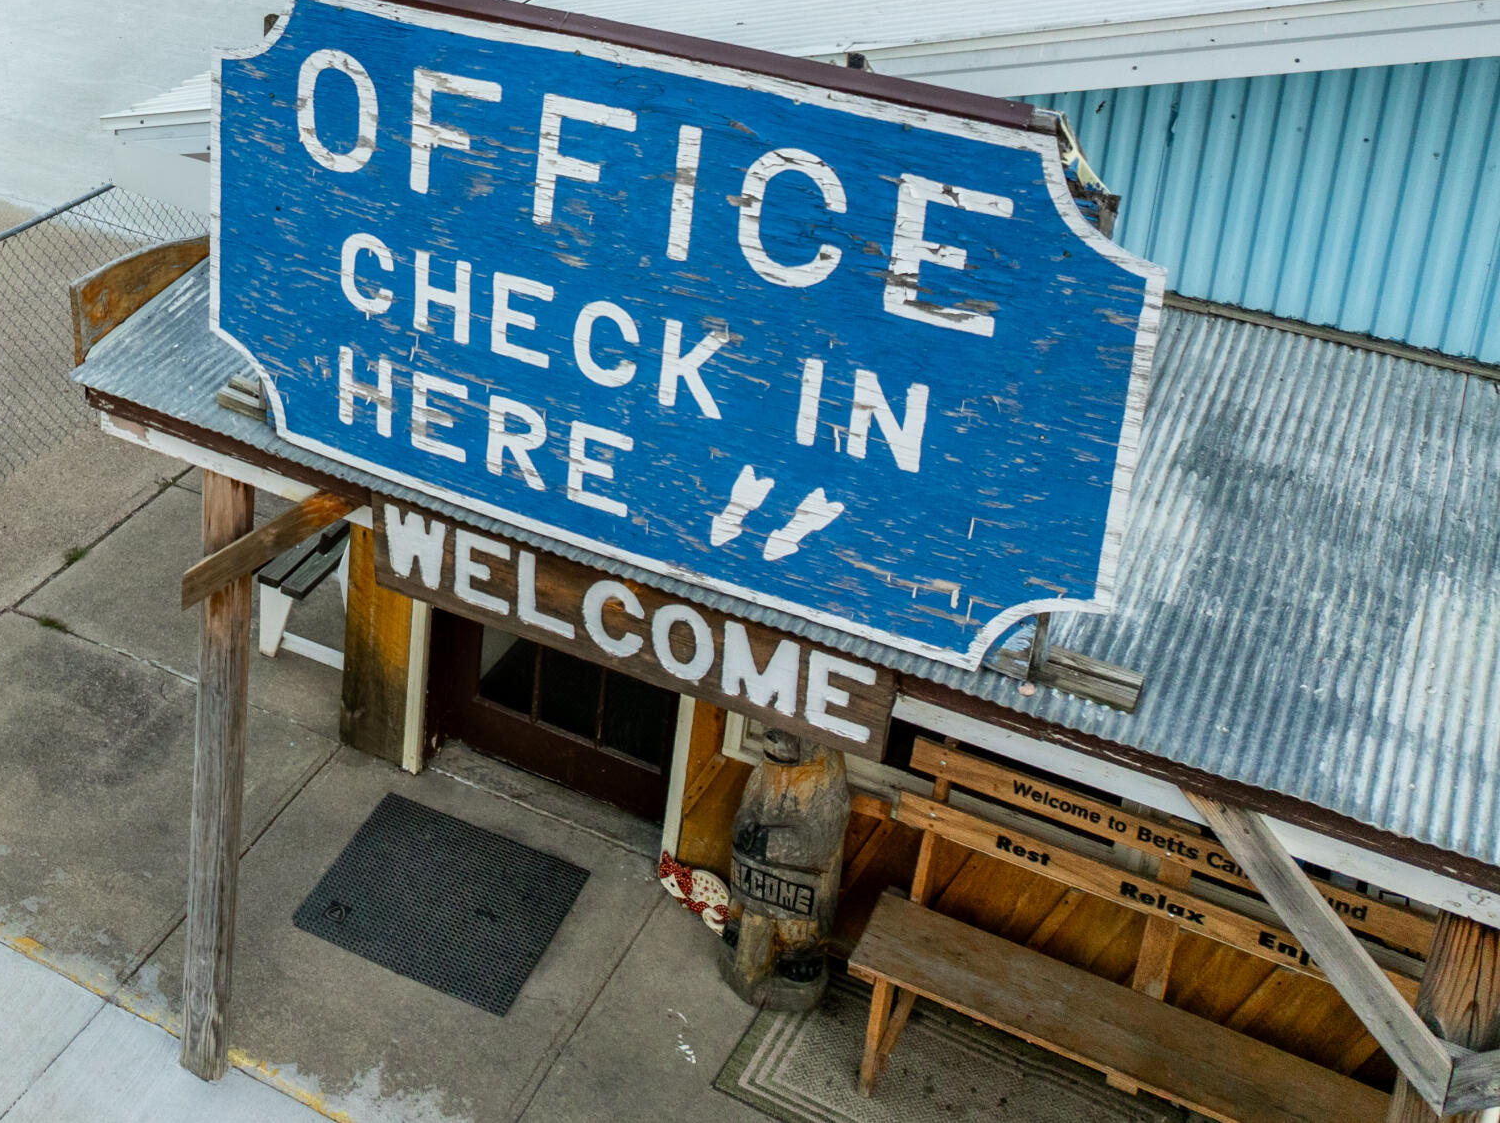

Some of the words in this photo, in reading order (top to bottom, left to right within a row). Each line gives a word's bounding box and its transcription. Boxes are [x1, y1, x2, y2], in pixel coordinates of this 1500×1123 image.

[298, 48, 1014, 338] OFFICE
[338, 345, 633, 518] HERE
[339, 232, 730, 421] CHECK
[795, 357, 930, 473] IN
[384, 501, 878, 743] WELCOME
[995, 834, 1051, 866] Rest
[1119, 880, 1206, 926] Relax
[1012, 779, 1102, 825] Welcome
[1107, 814, 1128, 833] to
[1135, 825, 1200, 861] Betts
